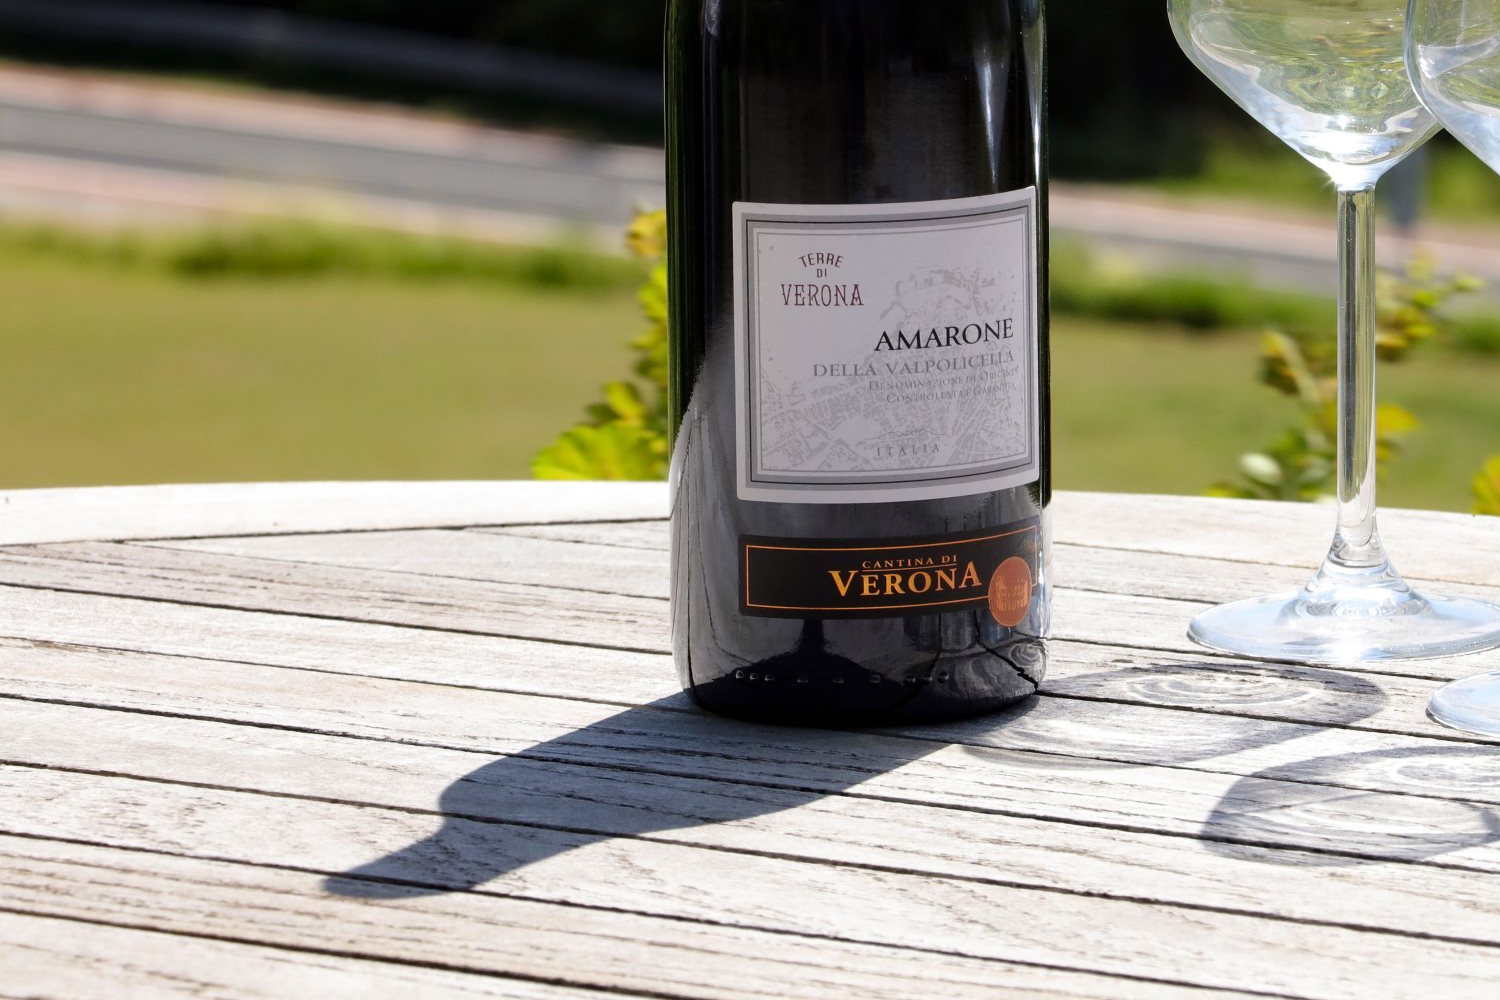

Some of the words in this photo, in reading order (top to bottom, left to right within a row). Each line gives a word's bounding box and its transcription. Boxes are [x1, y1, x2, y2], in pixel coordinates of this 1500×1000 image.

[798, 252, 845, 268] TERRE
[816, 268, 827, 278] DI
[781, 284, 864, 307] VERONA
[874, 318, 1014, 351] AMARONE
[813, 363, 878, 377] DELLA
[885, 350, 1015, 376] VALPOLICELLA
[868, 376, 964, 391] DENOMINAZIONE
[876, 444, 940, 457] ITALIA
[862, 557, 934, 569] CANTINA
[941, 554, 957, 563] DI
[827, 561, 983, 597] VERONA
